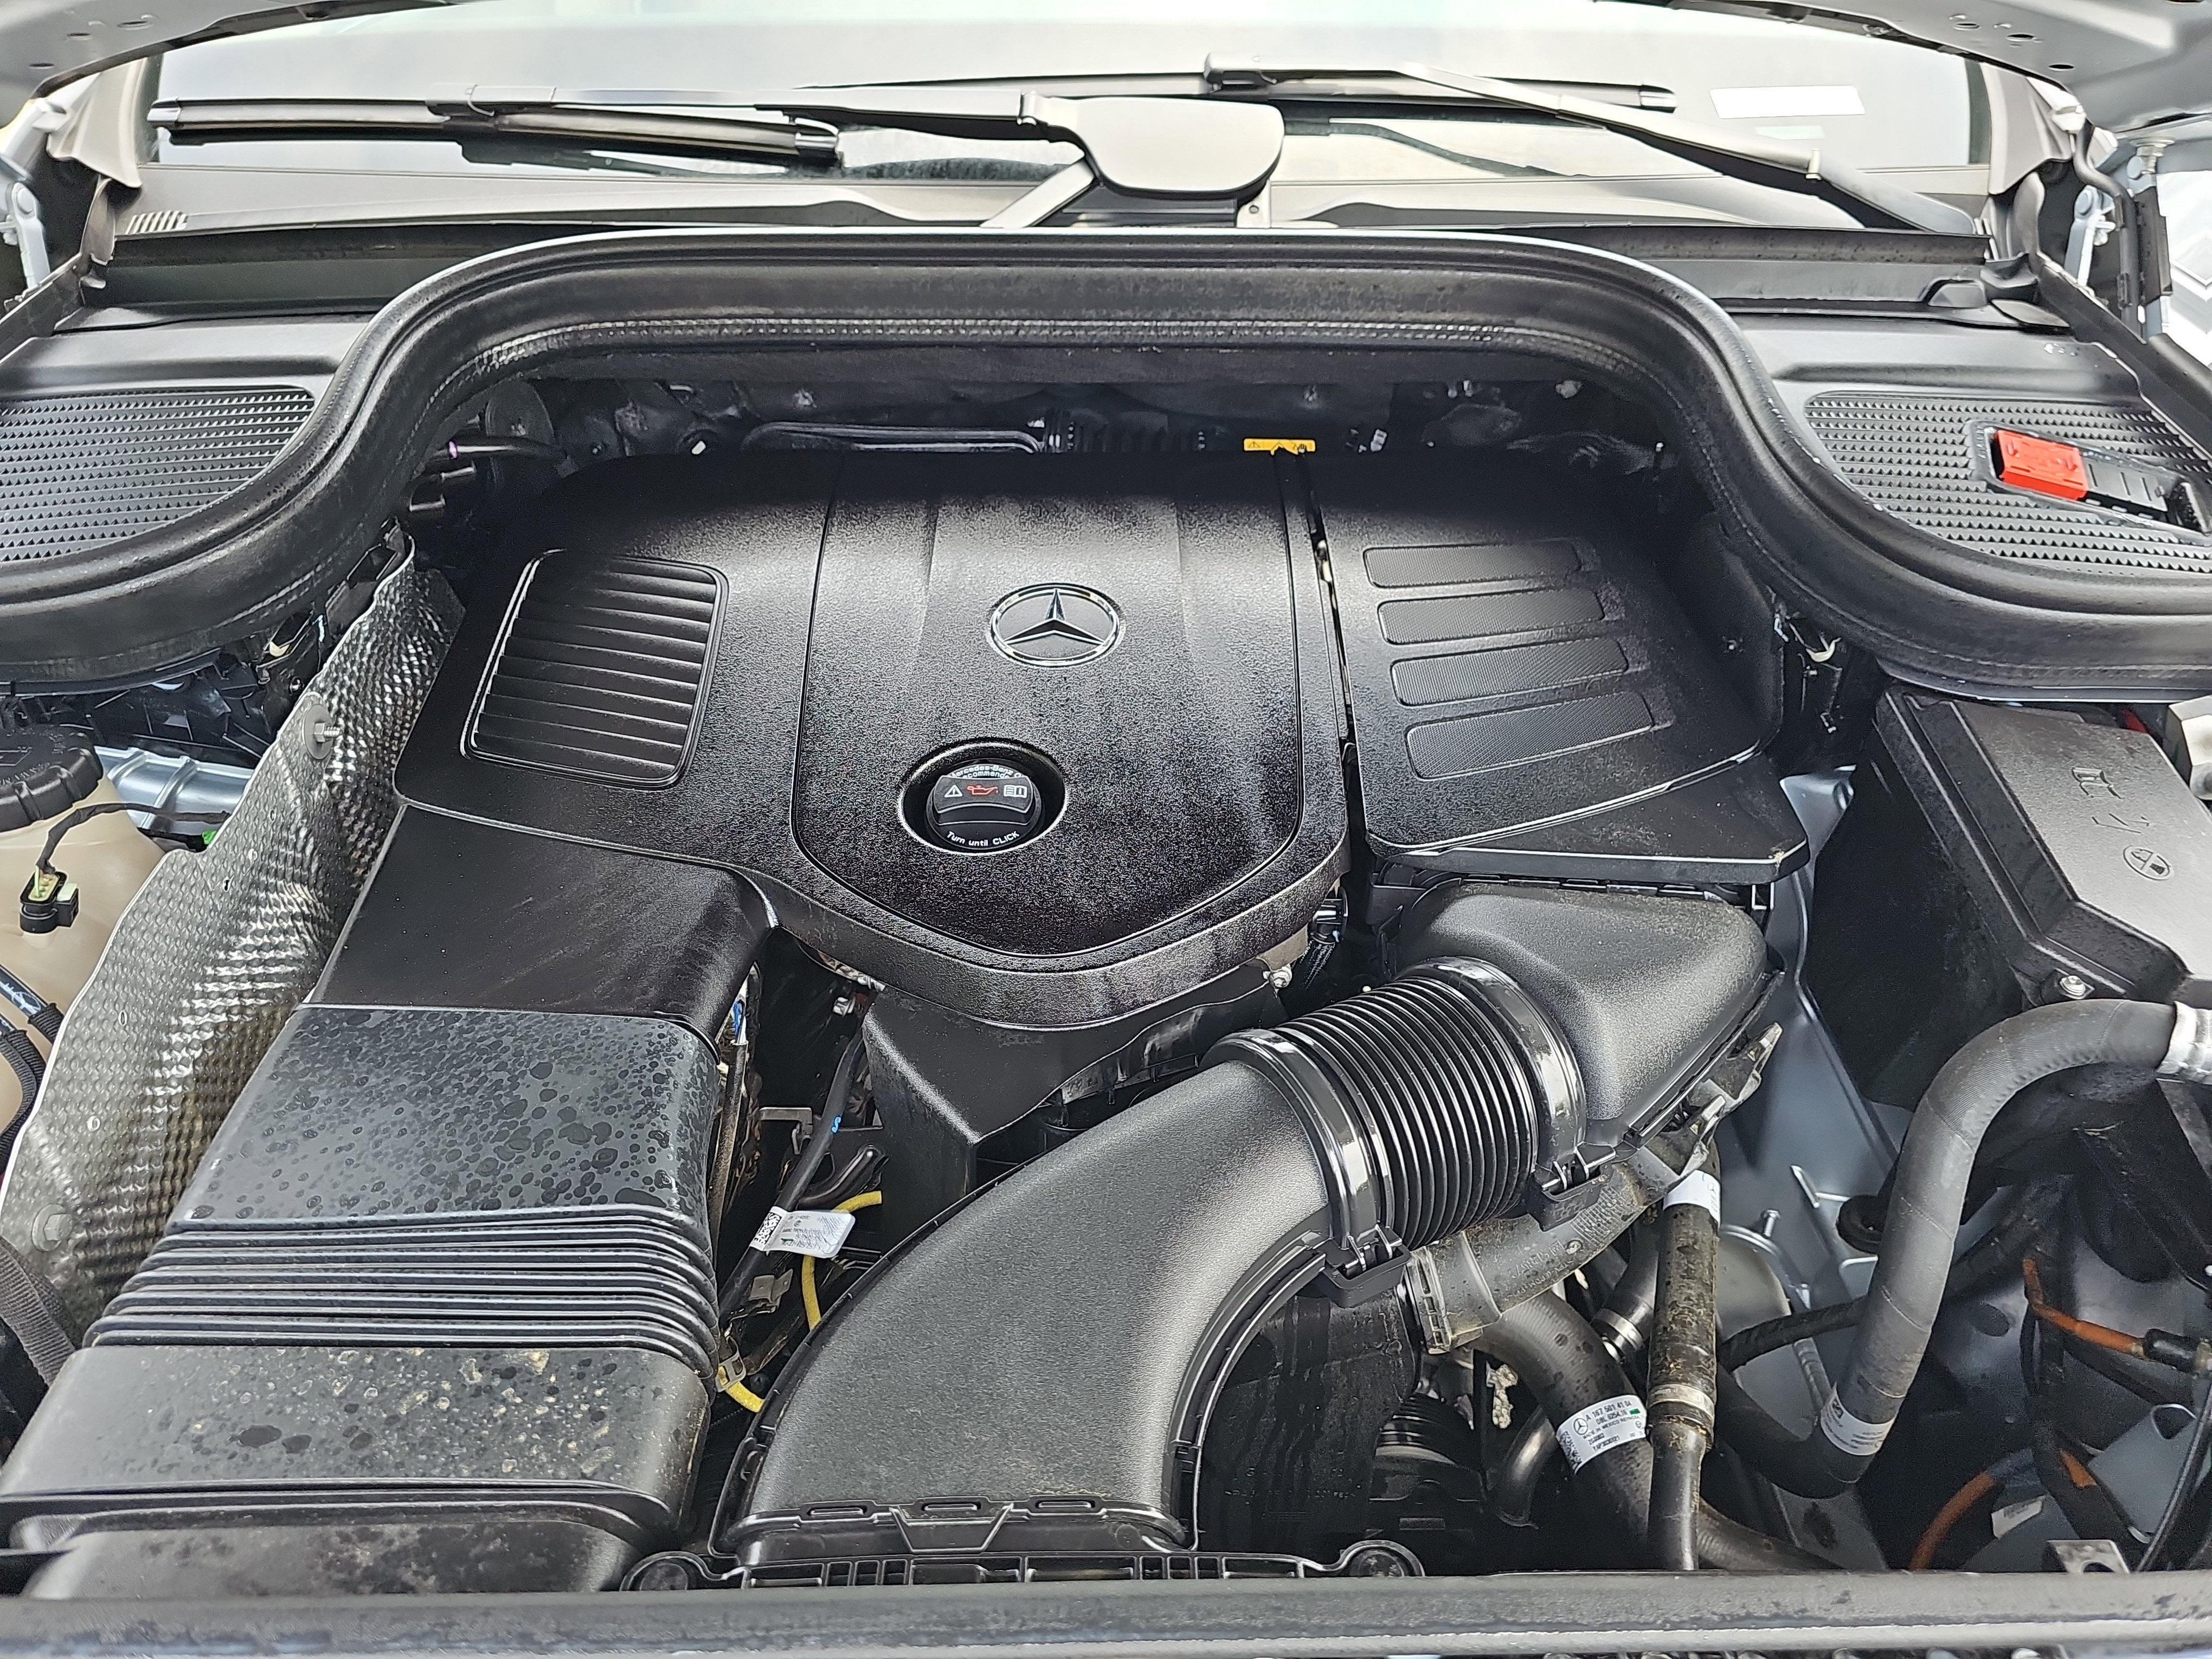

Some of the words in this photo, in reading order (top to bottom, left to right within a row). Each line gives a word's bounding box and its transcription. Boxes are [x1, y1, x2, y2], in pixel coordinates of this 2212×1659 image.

[947, 831, 966, 844] Turn
[992, 831, 1020, 845] CLICK
[1601, 1420, 1620, 1430] MEXICO
